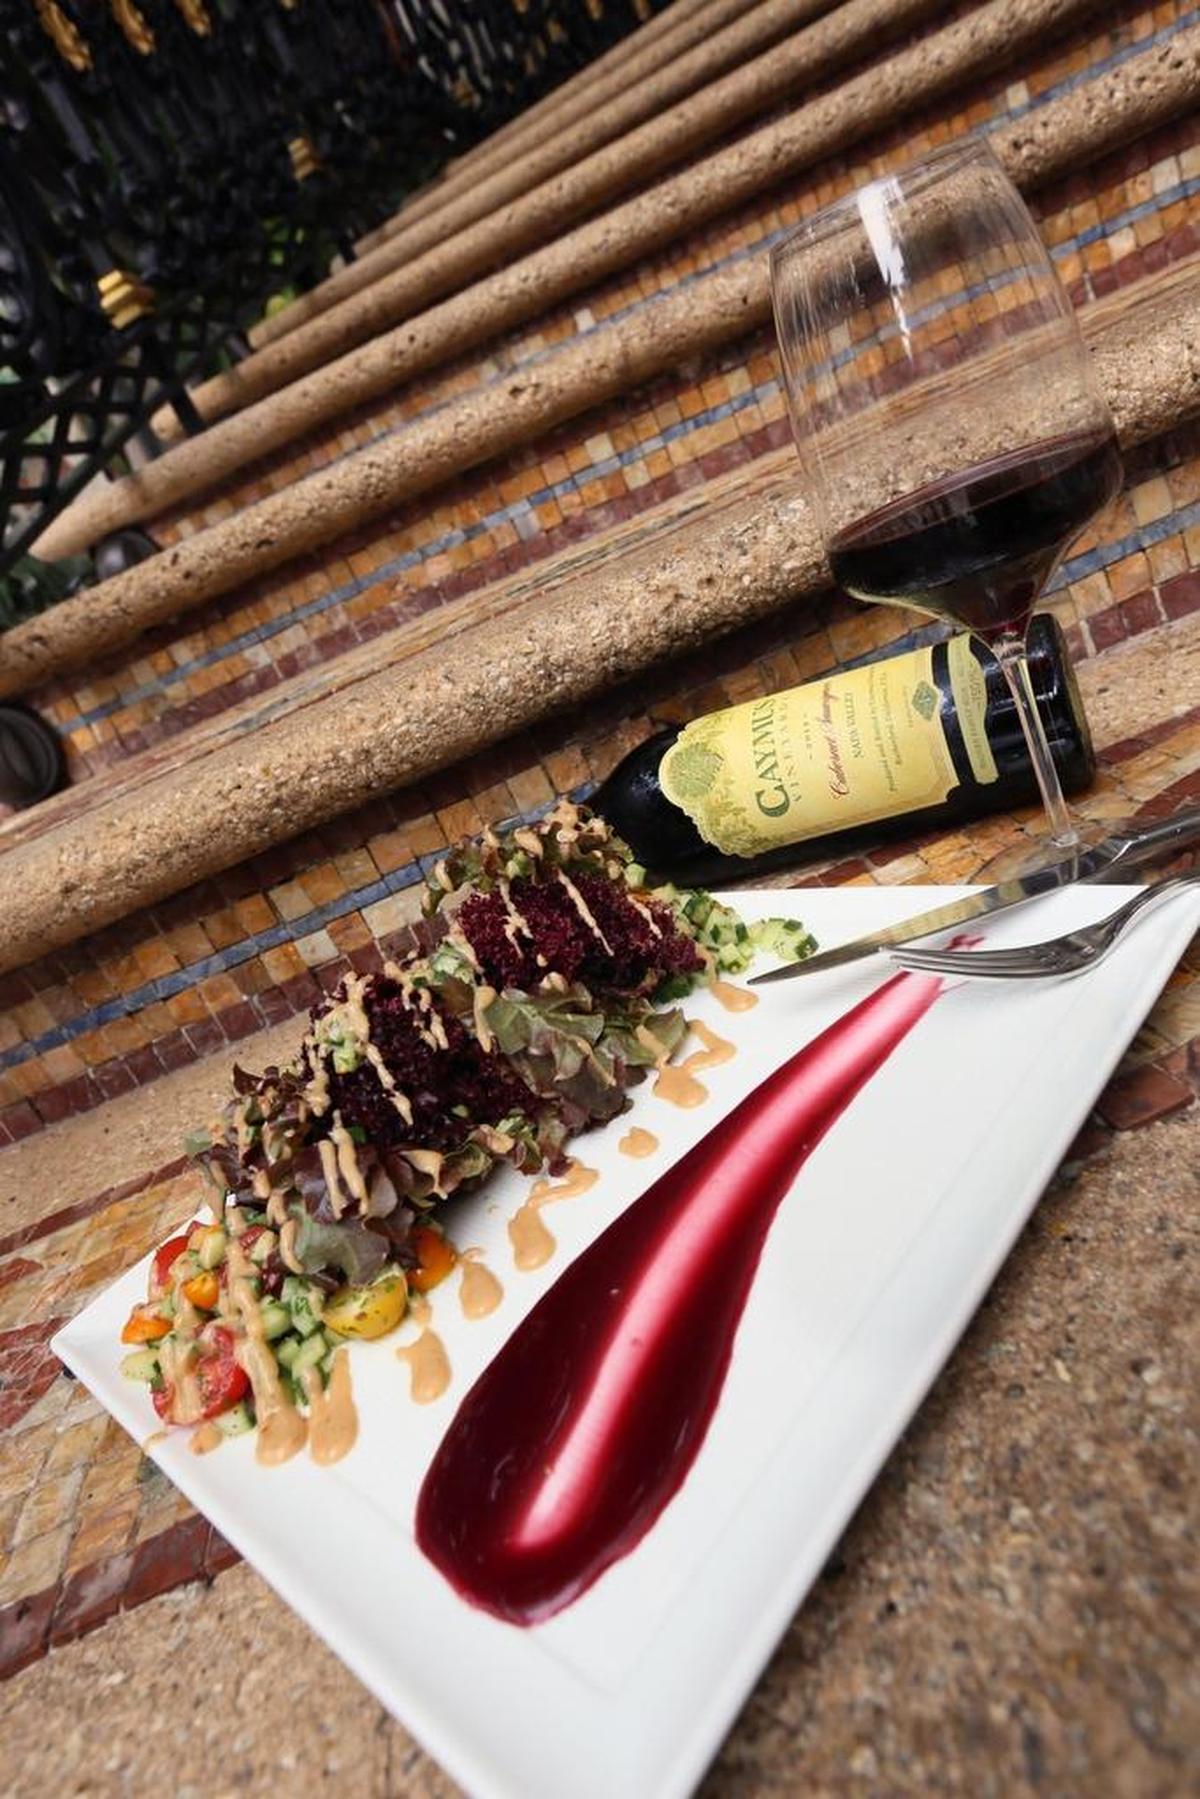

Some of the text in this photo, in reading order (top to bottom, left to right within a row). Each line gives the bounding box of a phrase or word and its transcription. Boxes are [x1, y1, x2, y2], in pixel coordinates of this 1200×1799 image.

[752, 698, 790, 817] CAYMUS
[825, 728, 849, 800] Cabernet
[849, 728, 863, 758] NAPA
